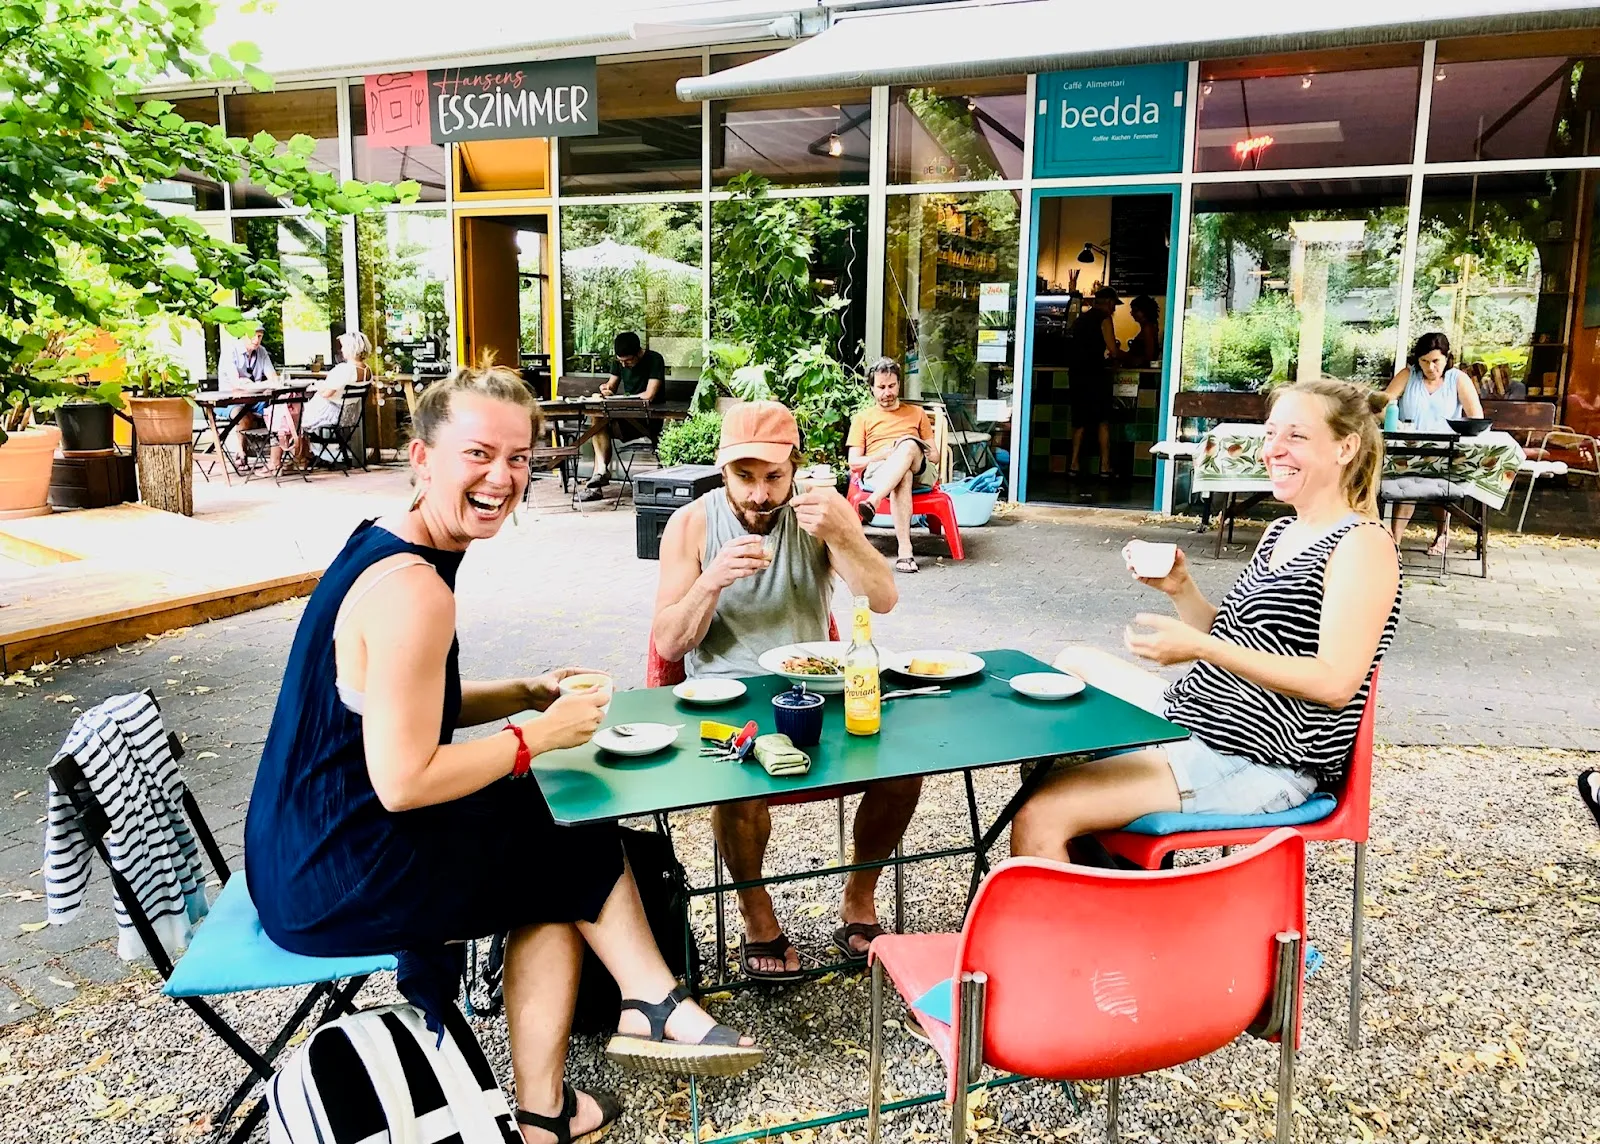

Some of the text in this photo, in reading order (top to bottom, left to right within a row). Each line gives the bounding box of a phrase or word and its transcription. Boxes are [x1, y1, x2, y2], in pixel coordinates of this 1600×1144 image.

[433, 67, 527, 96] Hansens
[1086, 79, 1125, 89] Alimentari
[1061, 95, 1159, 128] bedda
